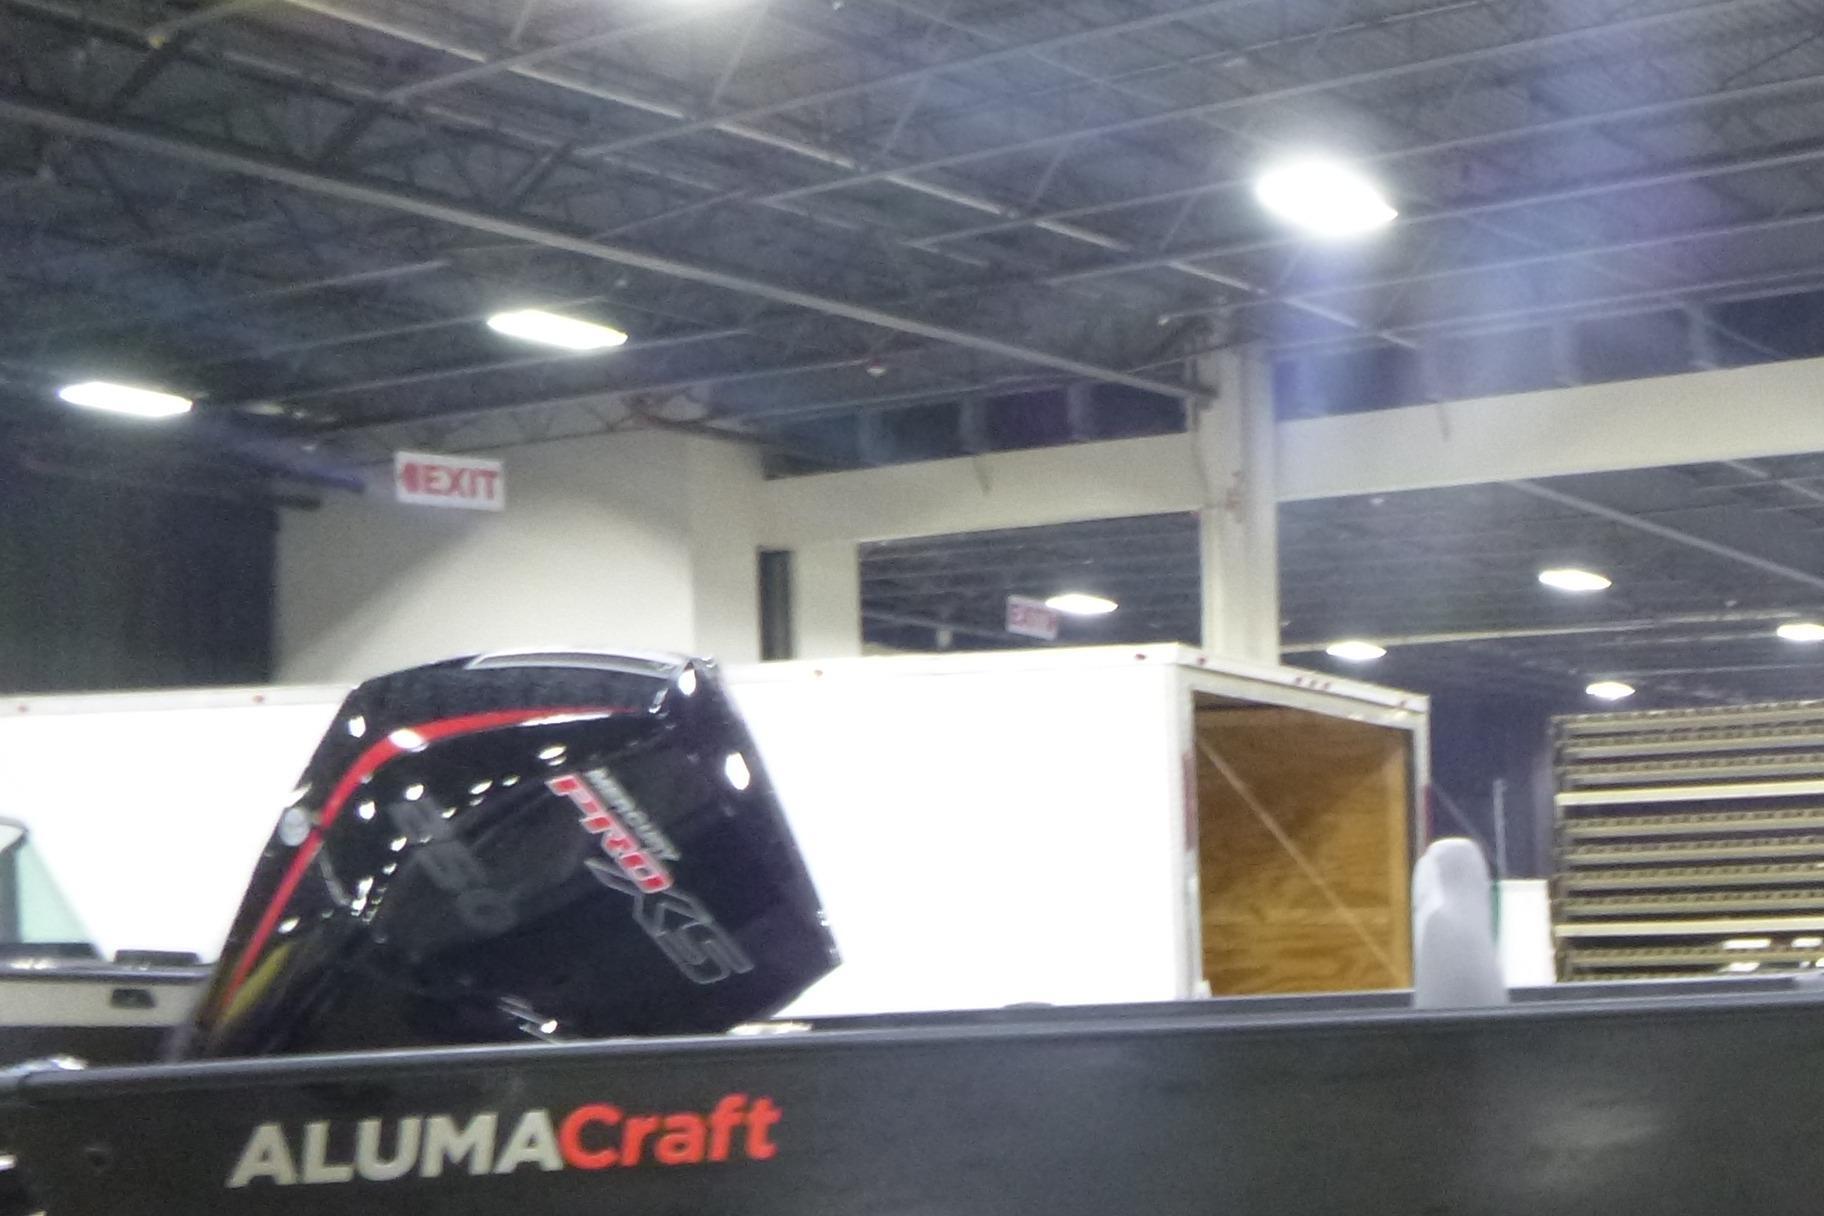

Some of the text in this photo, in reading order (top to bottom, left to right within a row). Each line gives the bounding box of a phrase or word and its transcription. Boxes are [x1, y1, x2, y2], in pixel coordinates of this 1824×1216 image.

[424, 463, 498, 500] EXIT
[545, 774, 673, 893] PRO
[225, 1094, 782, 1188] ALUMACraft
